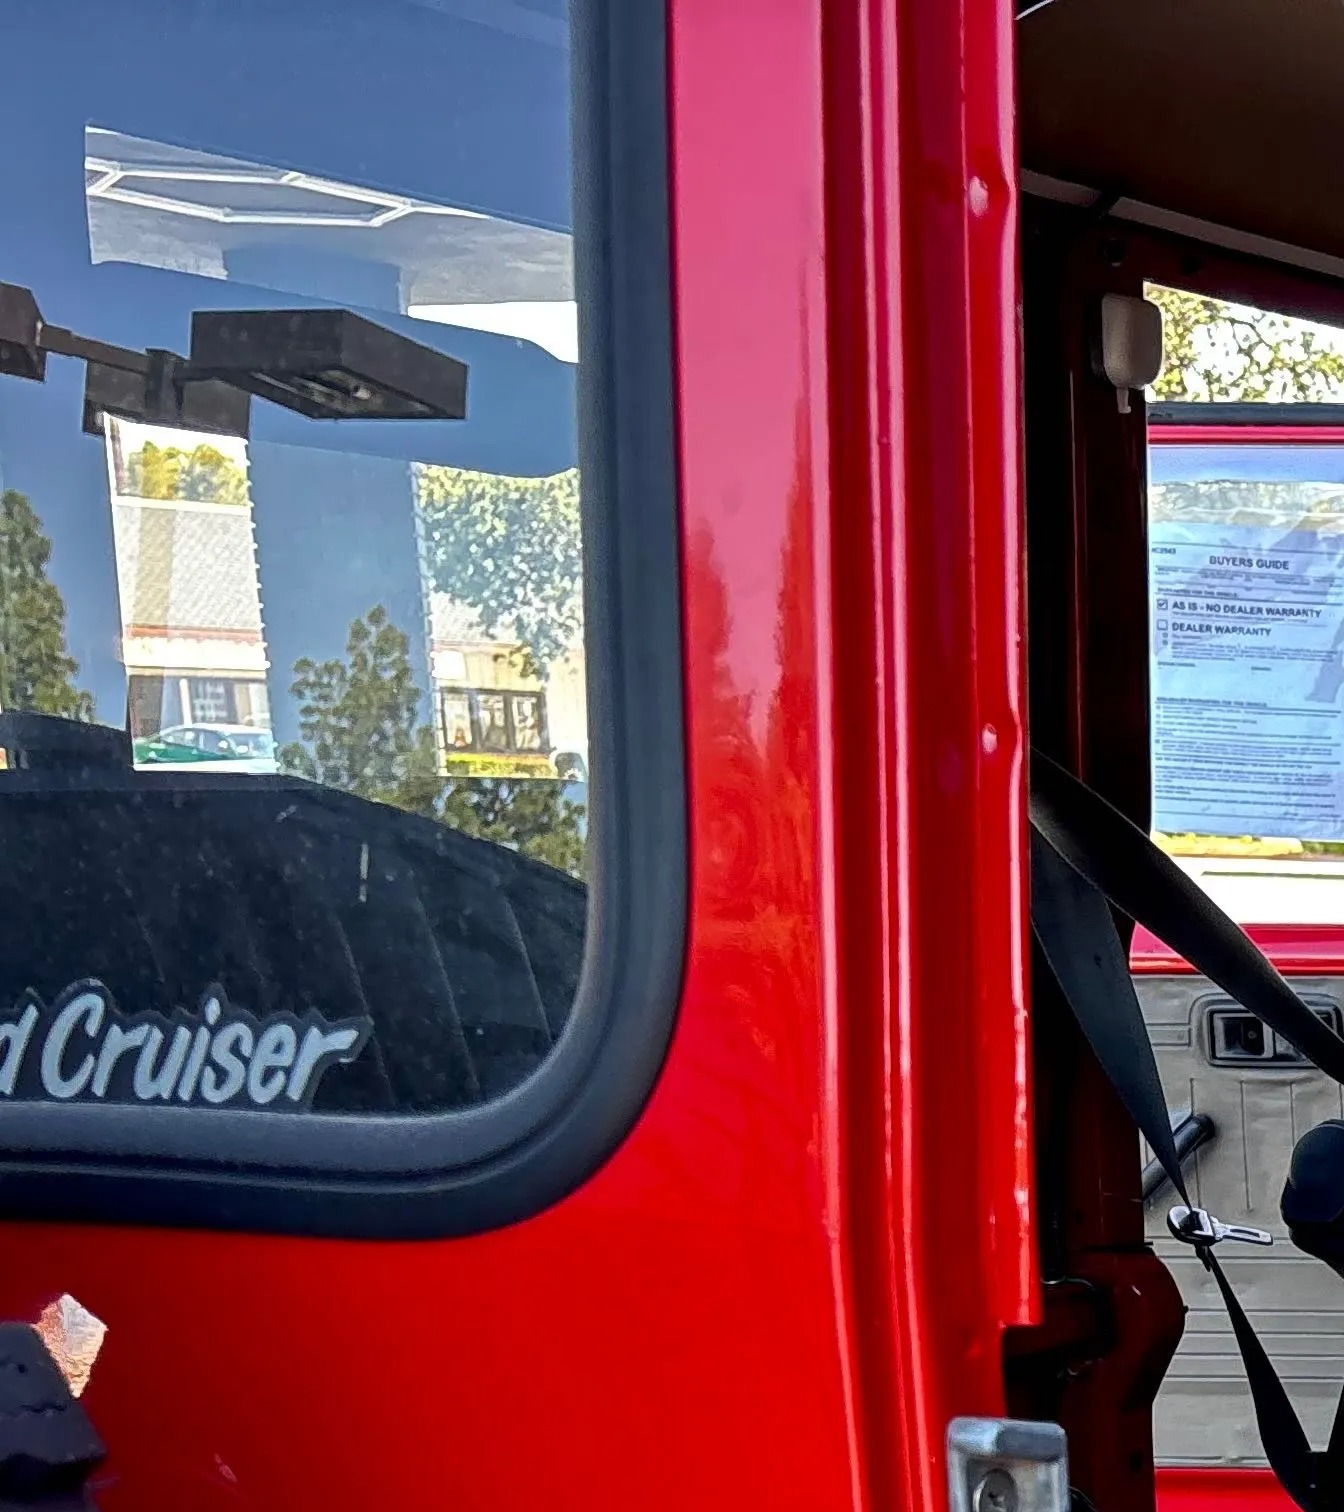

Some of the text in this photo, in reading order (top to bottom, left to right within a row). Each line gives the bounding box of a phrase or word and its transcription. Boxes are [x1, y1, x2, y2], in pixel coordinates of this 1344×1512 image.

[1209, 555, 1290, 570] BUYERS GUIDE
[1172, 600, 1186, 610] AS
[1188, 601, 1198, 611] IS
[1206, 603, 1221, 613] NO
[1223, 604, 1263, 616] DEALER
[1266, 606, 1322, 618] WARRANTY
[1172, 622, 1272, 637] DEALER WARRANTY
[41, 993, 359, 1104] Cruiser
